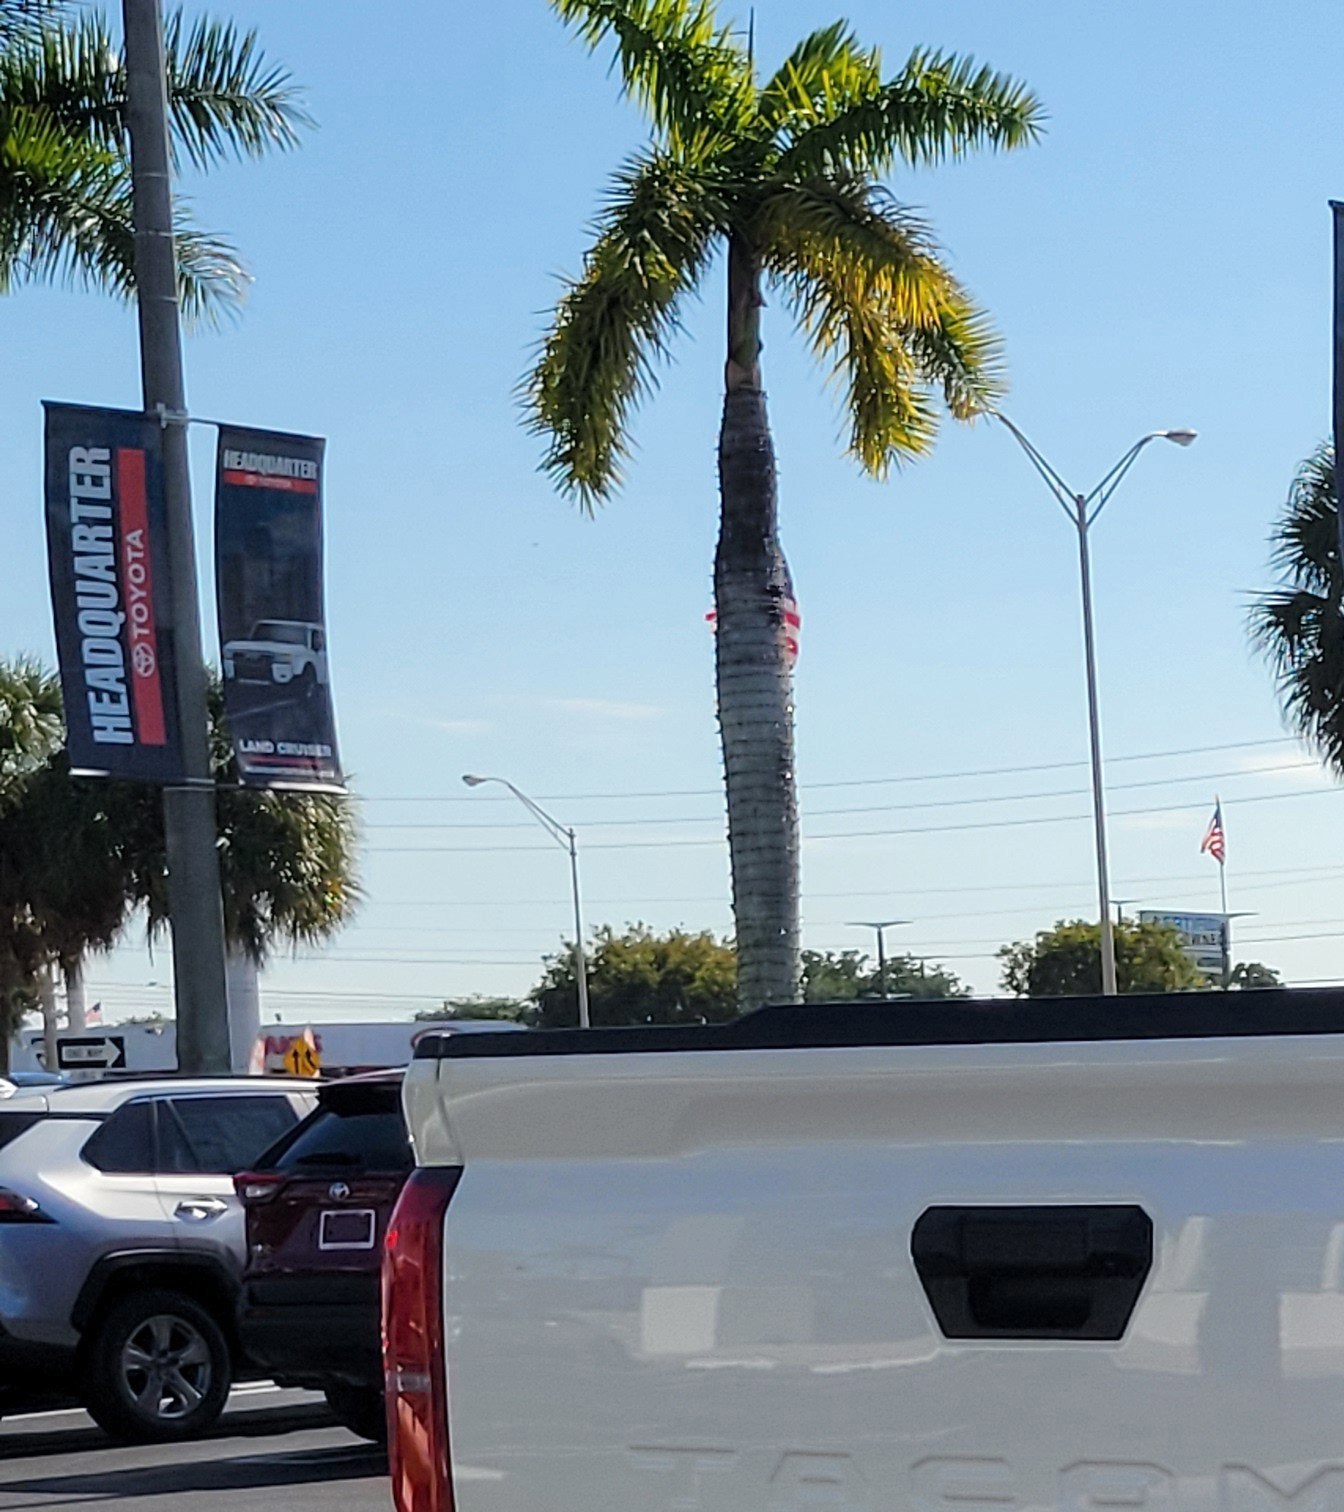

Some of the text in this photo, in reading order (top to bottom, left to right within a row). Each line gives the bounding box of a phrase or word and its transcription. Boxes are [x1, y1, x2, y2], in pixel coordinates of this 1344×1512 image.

[223, 449, 318, 480] HEADQUARTER
[68, 445, 135, 746] HEADQUARTER
[124, 528, 153, 640] TOYOTA
